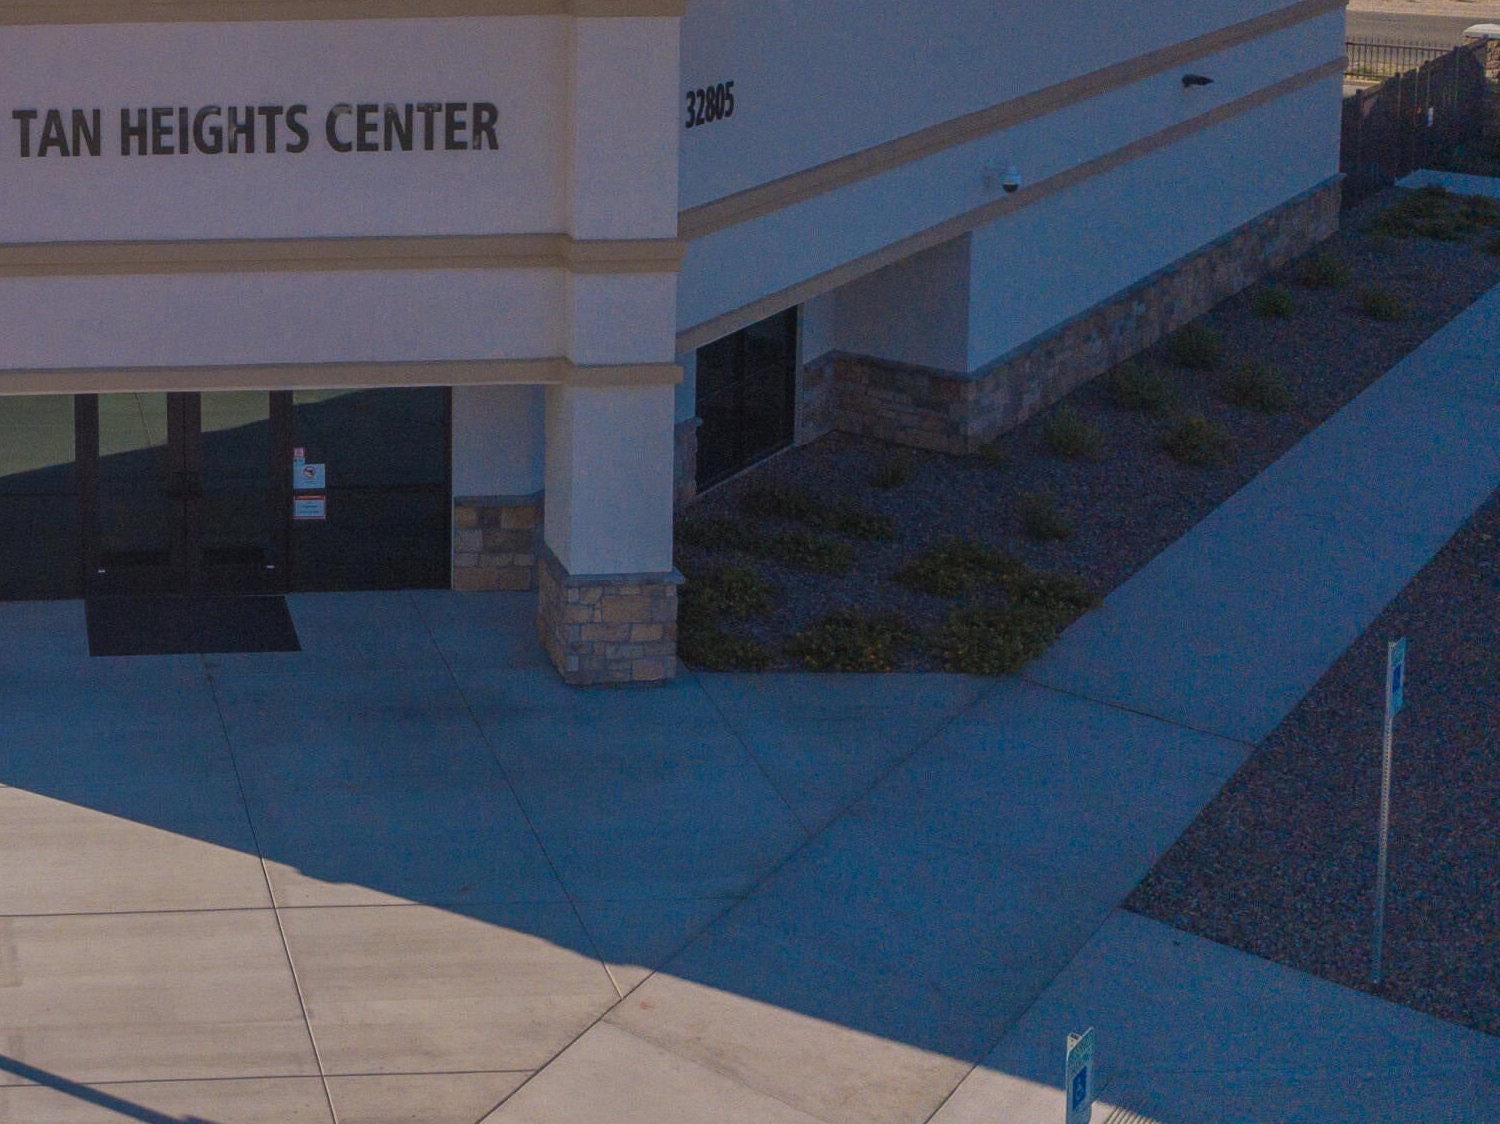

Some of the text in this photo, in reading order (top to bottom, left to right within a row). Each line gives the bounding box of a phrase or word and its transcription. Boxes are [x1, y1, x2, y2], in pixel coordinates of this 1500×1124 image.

[11, 108, 101, 158] TAN
[120, 104, 310, 157] HEIGHTS
[325, 101, 500, 153] CENTER
[685, 81, 735, 129] 32805
